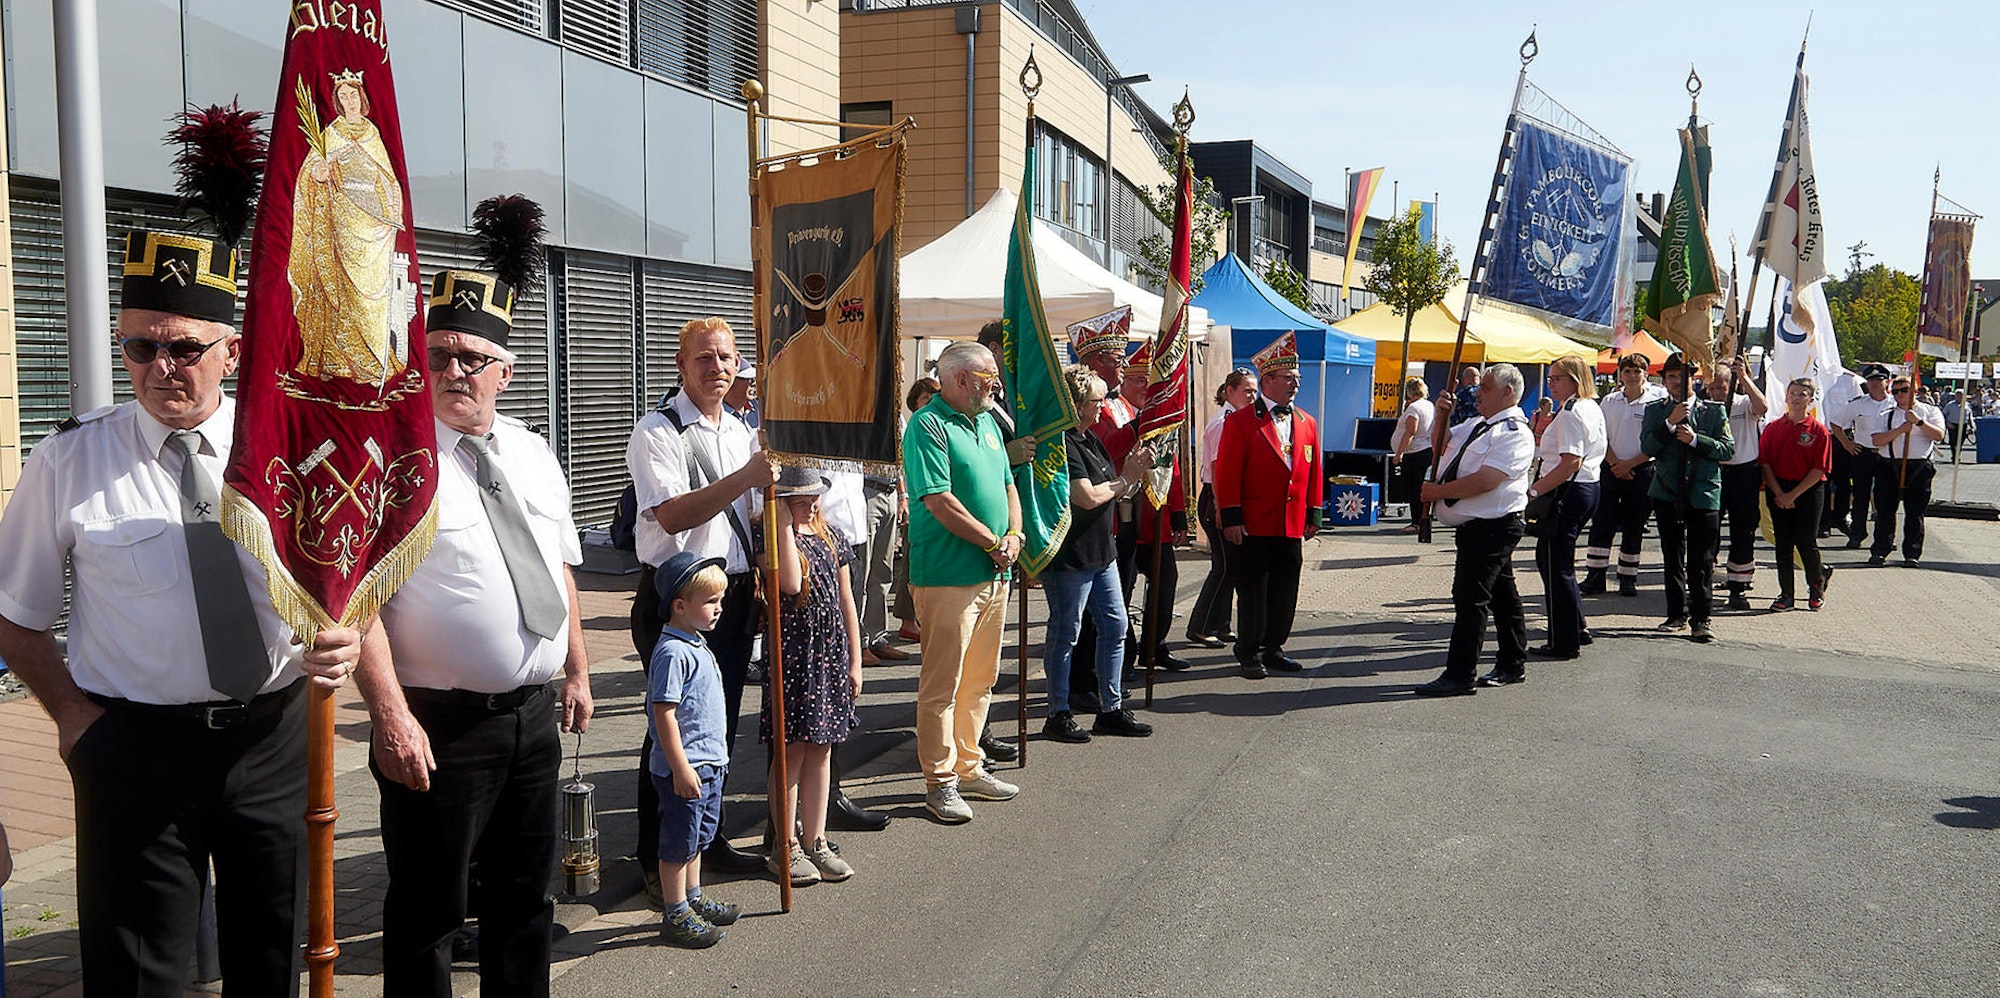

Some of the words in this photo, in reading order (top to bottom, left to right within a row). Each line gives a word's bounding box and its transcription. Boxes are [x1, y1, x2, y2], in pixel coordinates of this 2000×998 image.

[1801, 175, 1820, 215] Rotes
[1800, 221, 1823, 262] Kreuz
[1159, 333, 1189, 373] KOMME
